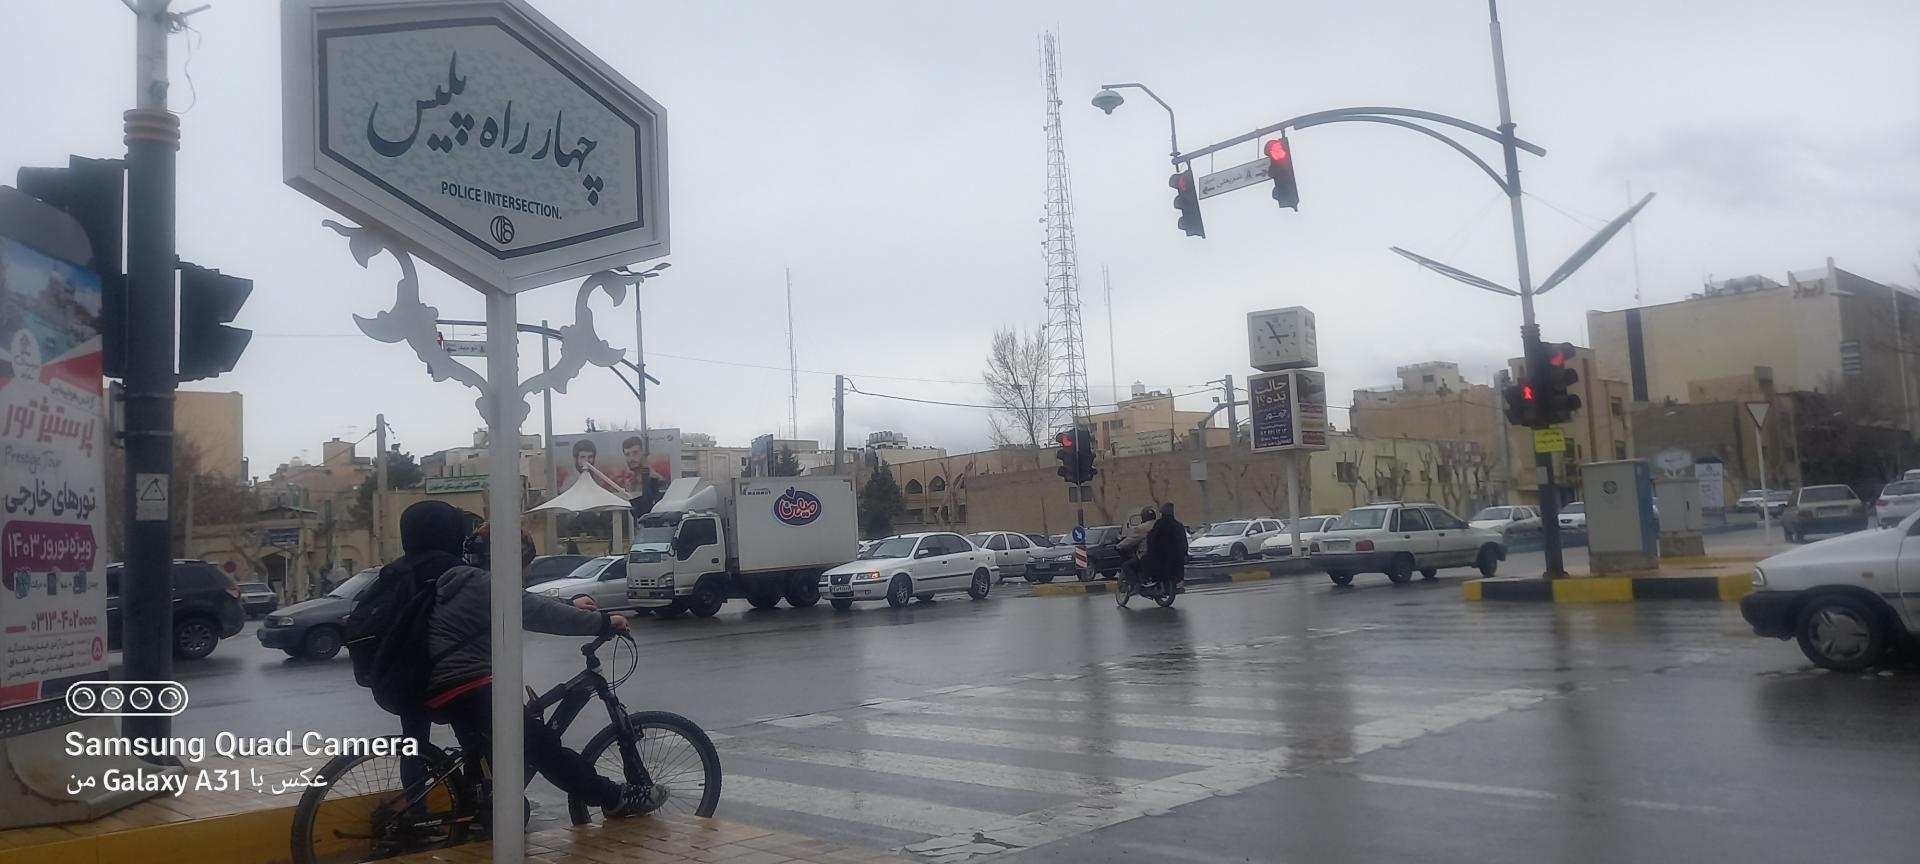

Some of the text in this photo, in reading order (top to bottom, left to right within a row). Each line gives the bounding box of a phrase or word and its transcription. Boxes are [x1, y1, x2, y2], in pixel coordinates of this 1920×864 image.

[366, 50, 604, 206] چهار راه پلیس
[441, 181, 563, 220] POLICE INTERSECTION.
[2, 395, 95, 458] پرستیژ تور
[5, 479, 96, 520] تورهای خارجی
[779, 497, 818, 521] میهن
[8, 532, 92, 561] ویژه نوروز ۱۴۰۳
